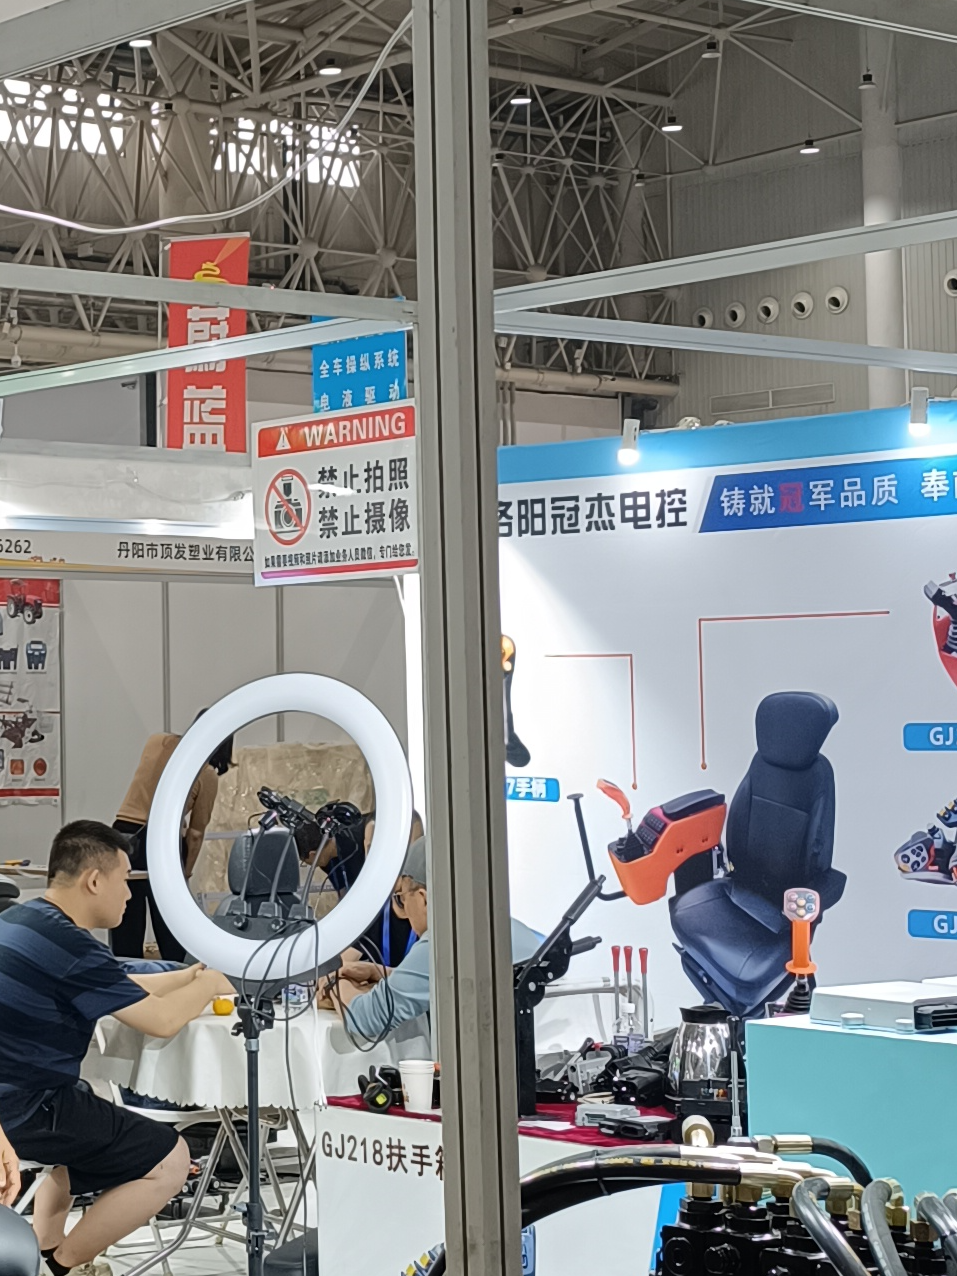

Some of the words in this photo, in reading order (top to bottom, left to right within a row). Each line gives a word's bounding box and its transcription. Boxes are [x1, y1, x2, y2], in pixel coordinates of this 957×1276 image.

[319, 348, 400, 379] 全车操纵系统
[303, 411, 407, 448] WARNING
[317, 456, 410, 499] 禁止拍照
[719, 473, 899, 517] 铸就冠军品质
[920, 467, 957, 502] 奉
[318, 497, 411, 539] 禁止摄像
[928, 726, 957, 746] GJ
